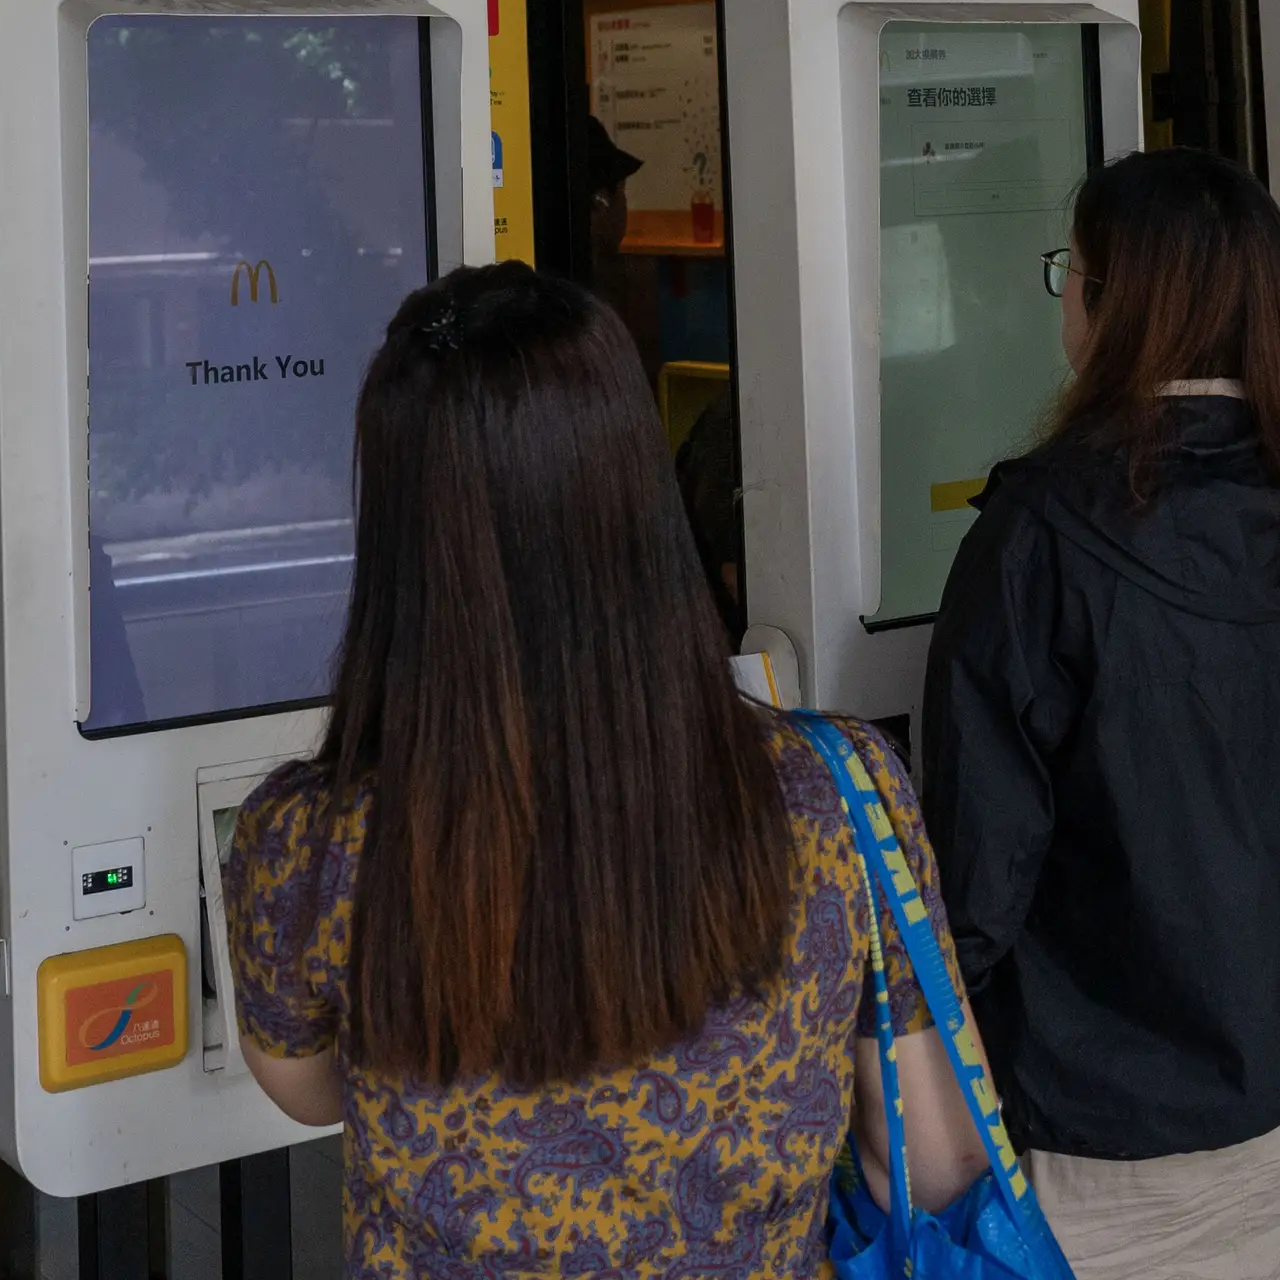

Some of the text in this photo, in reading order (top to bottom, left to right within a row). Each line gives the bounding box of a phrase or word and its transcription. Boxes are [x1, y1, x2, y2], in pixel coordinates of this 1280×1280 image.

[907, 87, 998, 108] 查看你的選擇
[186, 353, 325, 387] Thank You
[120, 1031, 160, 1045] Octopus
